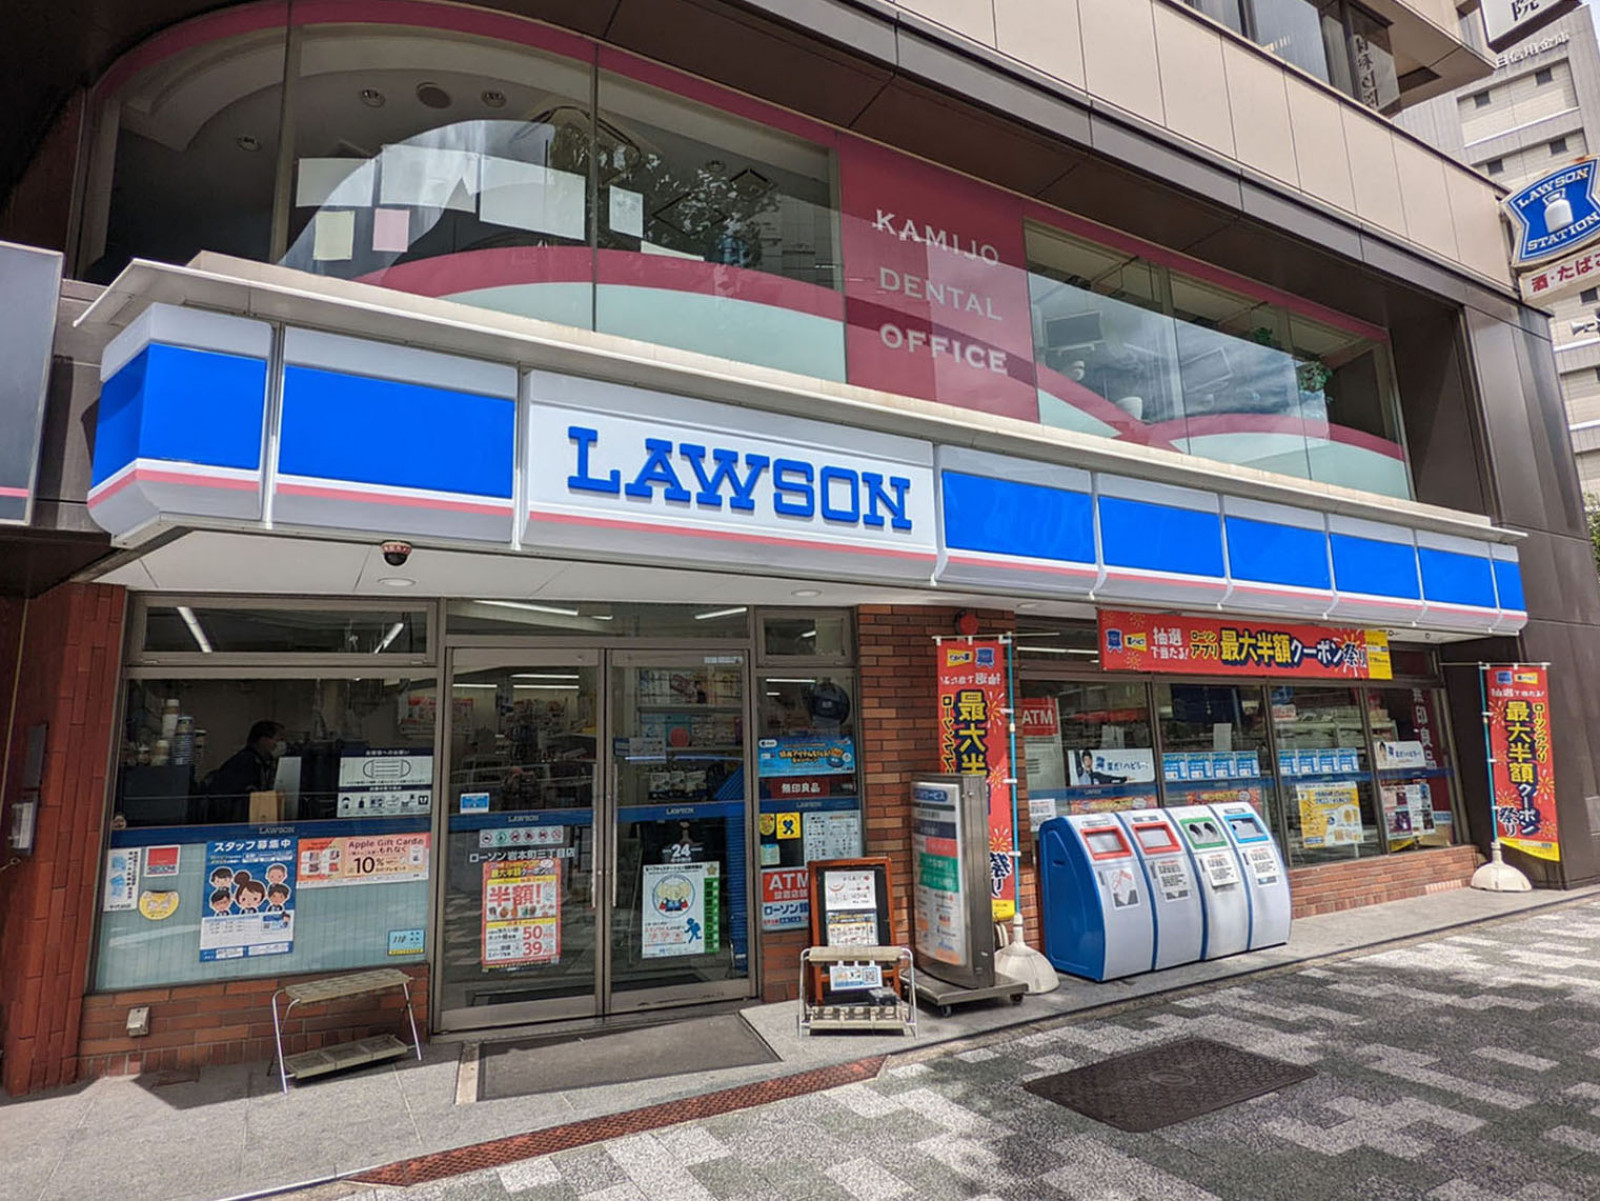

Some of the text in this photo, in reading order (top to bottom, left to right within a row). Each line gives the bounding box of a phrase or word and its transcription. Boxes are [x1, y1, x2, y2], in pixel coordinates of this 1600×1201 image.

[1517, 167, 1589, 208] LAWSON
[873, 209, 999, 265] KAMIJO
[1527, 210, 1600, 251] STATION
[1531, 252, 1600, 292] 酒・たば
[880, 266, 1002, 321] DENTAL
[880, 323, 1008, 375] OFFICE
[567, 425, 913, 530] LAWSON
[1153, 626, 1183, 646] 抽選
[1190, 630, 1217, 641] ローソン
[1191, 643, 1219, 660] アプリ
[1022, 709, 1053, 724] ATM
[213, 838, 292, 853] スタッフ募集中
[348, 840, 375, 851] Apple
[672, 844, 691, 858] 24
[769, 873, 808, 891] ATM
[523, 925, 543, 940] 50
[523, 940, 543, 956] 39
